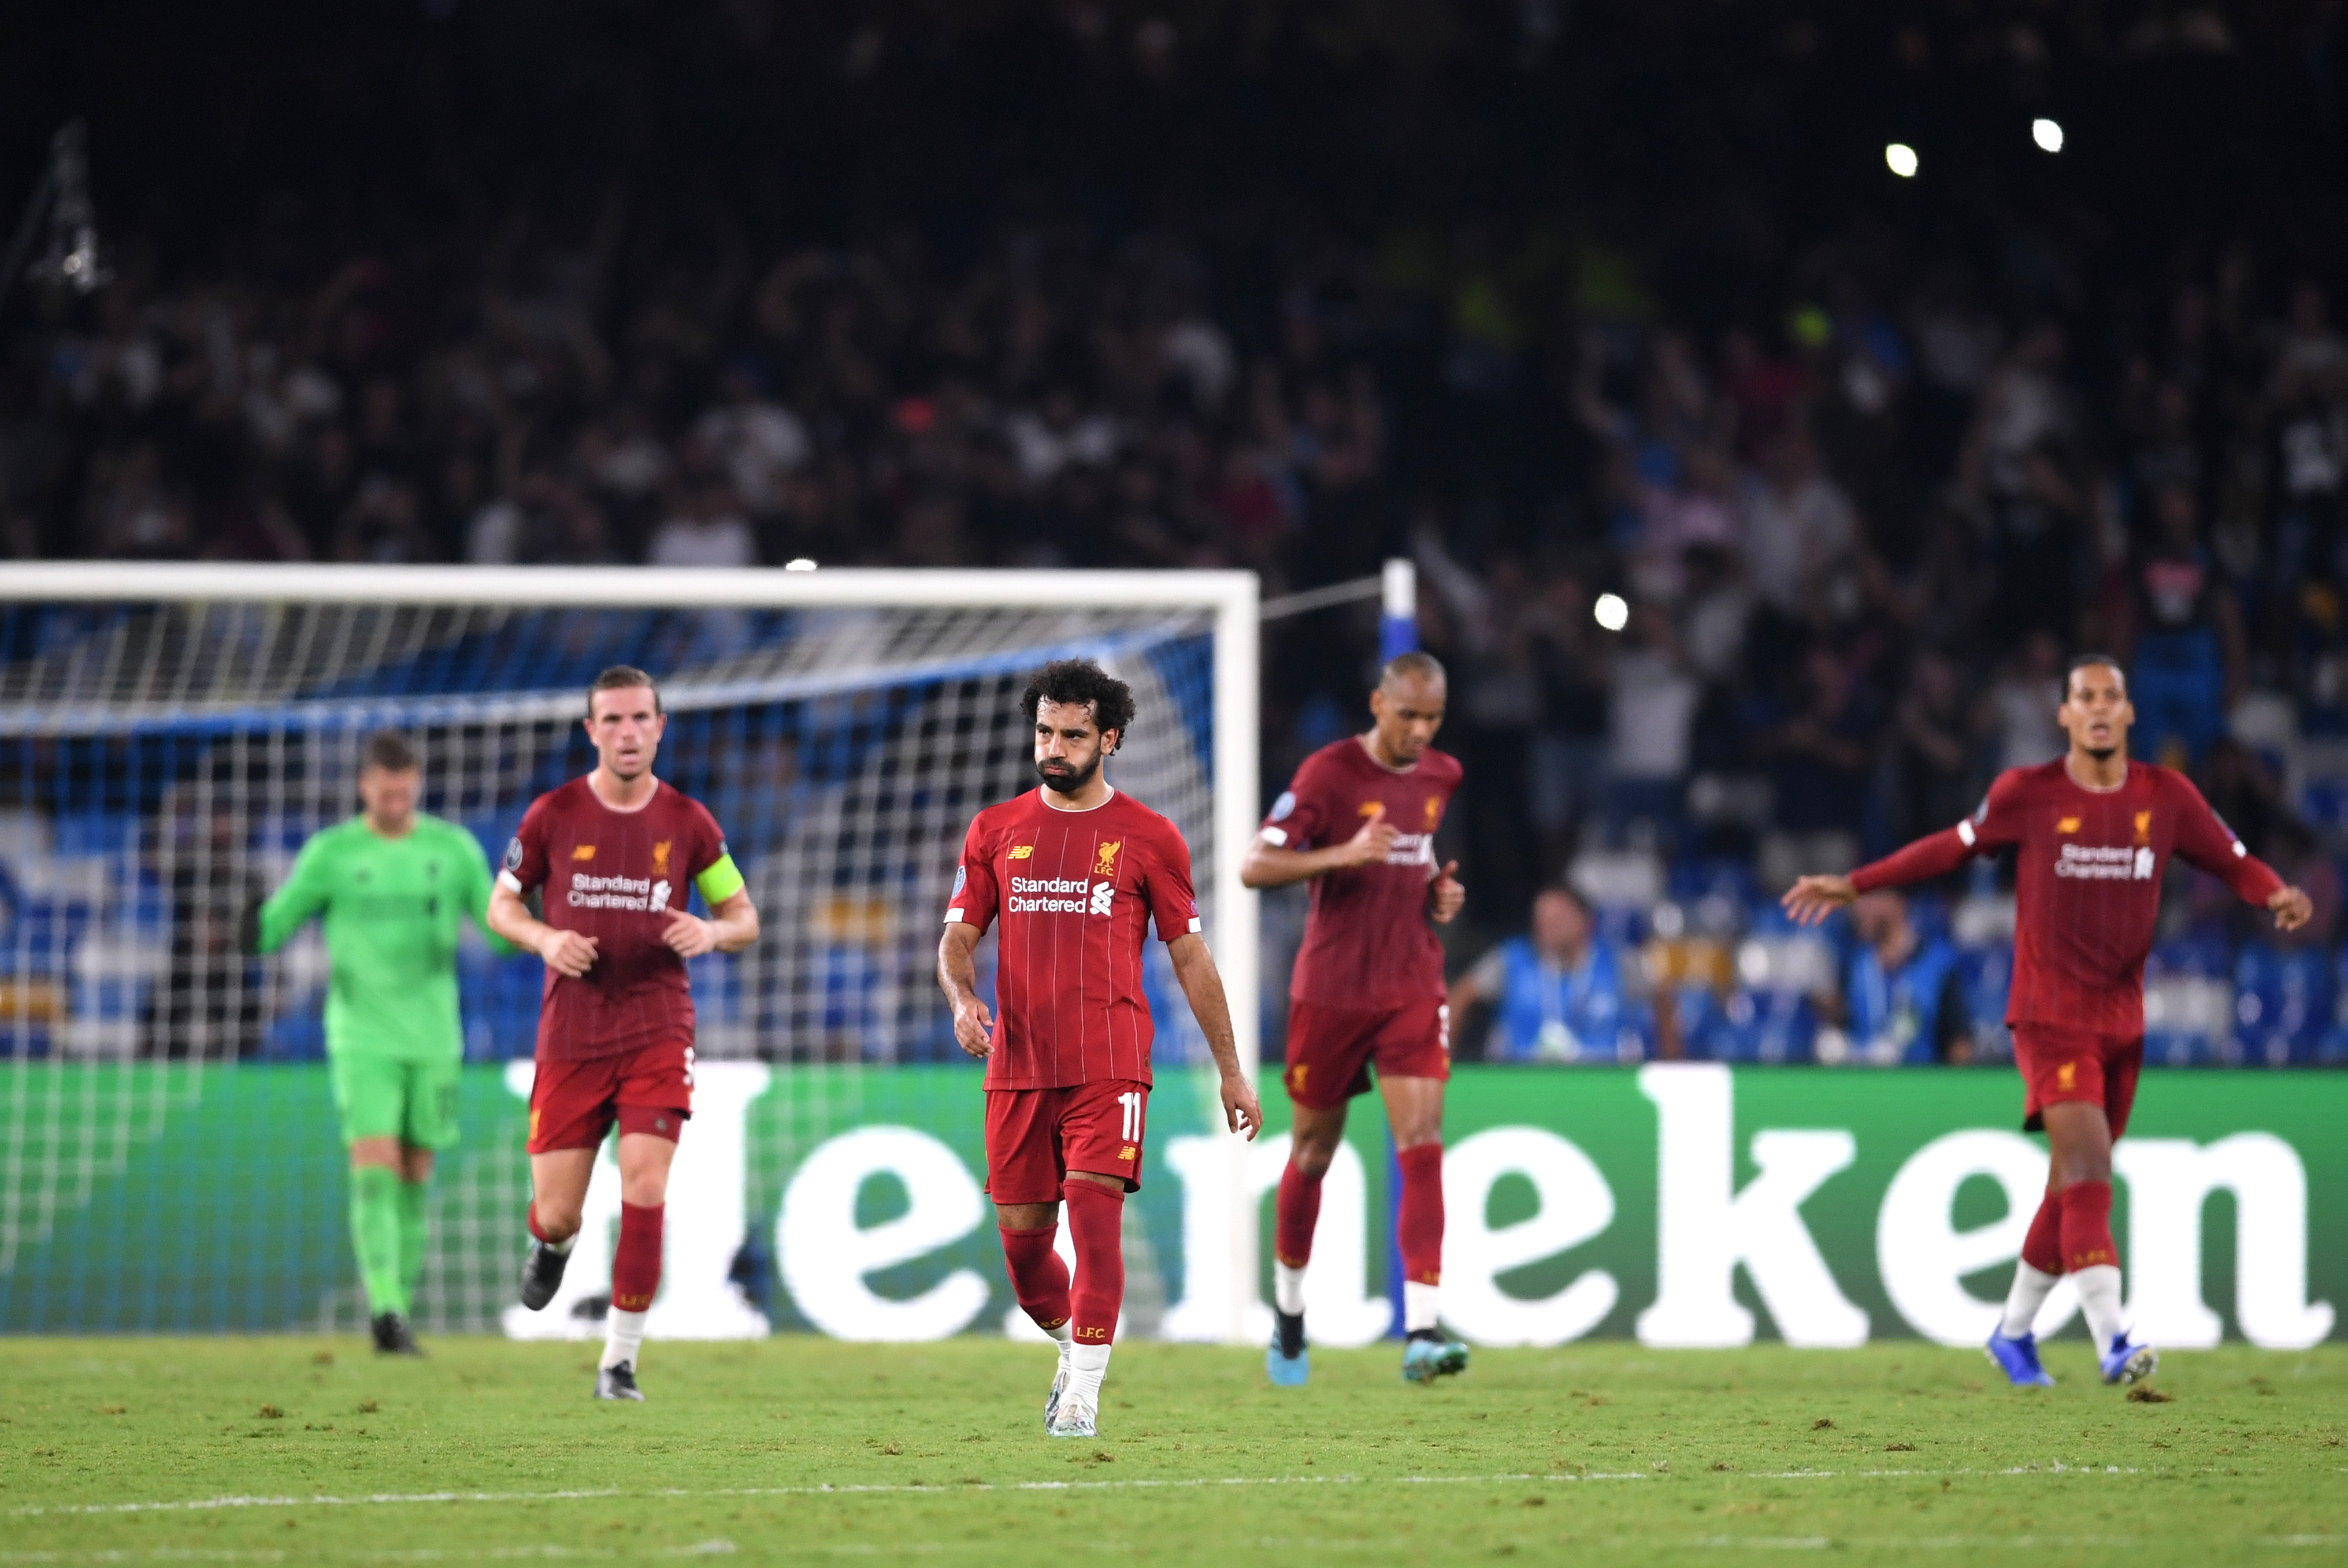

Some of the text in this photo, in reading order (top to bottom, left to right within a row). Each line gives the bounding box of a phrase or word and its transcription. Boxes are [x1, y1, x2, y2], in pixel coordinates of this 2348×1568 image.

[572, 873, 650, 894] Standard
[1011, 876, 1088, 894] Standard
[1008, 896, 1086, 913] Chartered
[1118, 1092, 1141, 1143] 11
[502, 1060, 2336, 1350] Heneken
